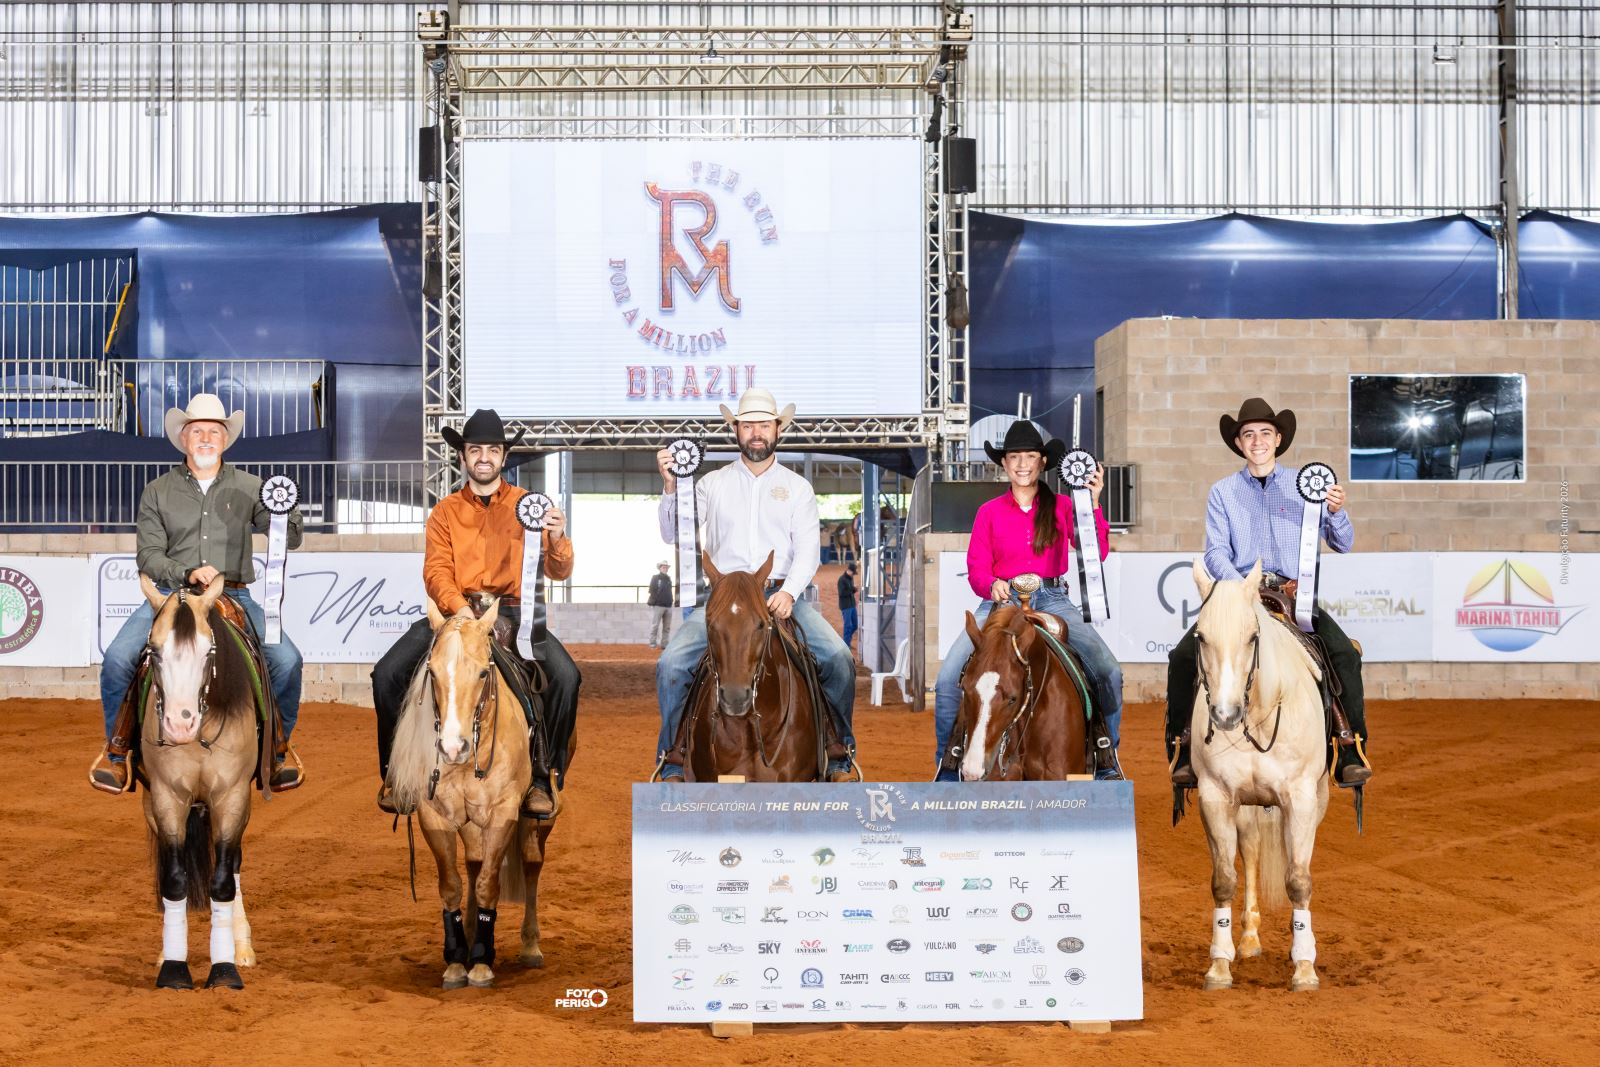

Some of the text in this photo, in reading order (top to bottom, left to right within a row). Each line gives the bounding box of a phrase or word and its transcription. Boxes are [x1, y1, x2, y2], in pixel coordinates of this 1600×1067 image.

[692, 160, 778, 243] THE RUN
[609, 258, 727, 354] FOR A MILLION
[289, 571, 427, 644] Maia
[1457, 610, 1561, 627] MARINA TAHITI
[369, 620, 403, 630] Reining
[661, 801, 756, 812] CLASSIFICATÓRIA
[765, 802, 790, 811] THE
[793, 802, 821, 811] RUN
[823, 801, 849, 811] FOR
[911, 801, 920, 810] A
[924, 800, 978, 810] MILLION
[981, 800, 1027, 809] BRAZIL
[1036, 799, 1087, 809] AMADOR
[670, 883, 684, 891] btg
[797, 910, 829, 918] DON
[758, 942, 781, 954] SKY
[924, 941, 956, 950] VULCANO
